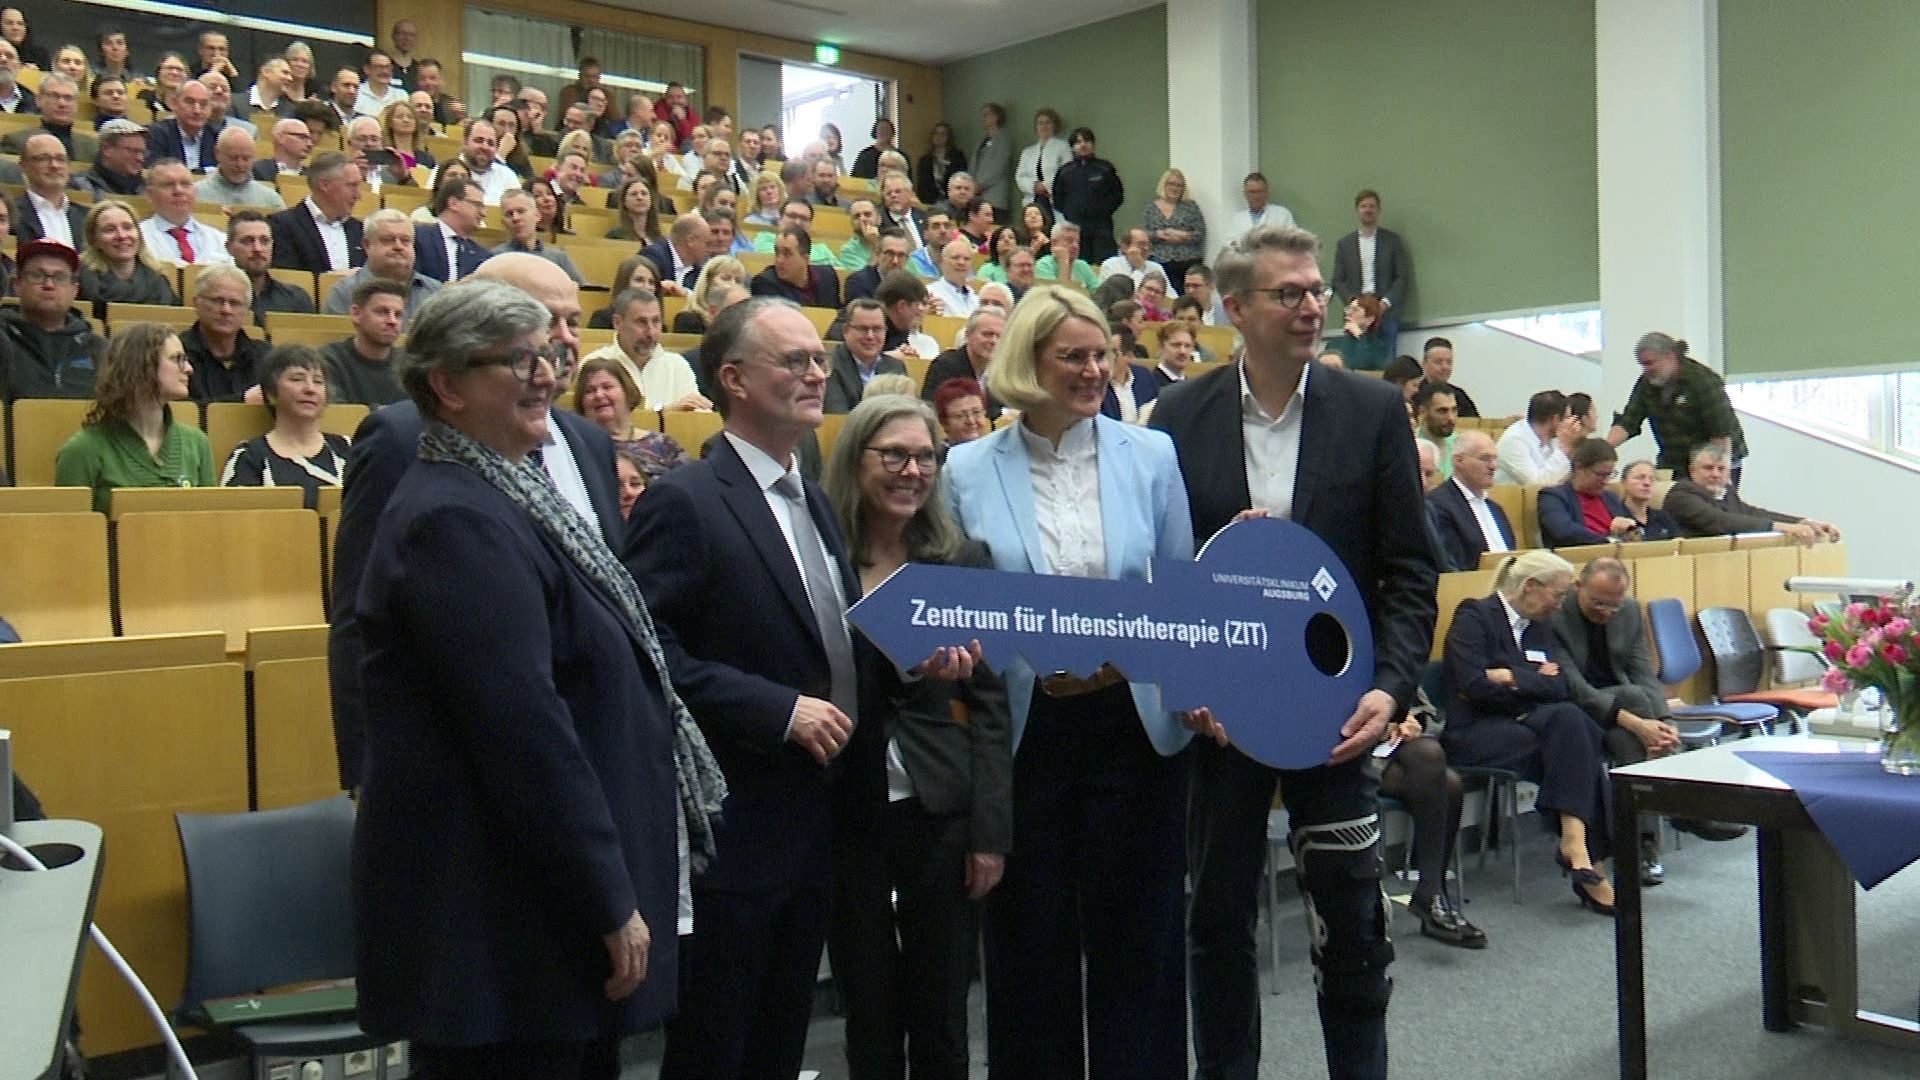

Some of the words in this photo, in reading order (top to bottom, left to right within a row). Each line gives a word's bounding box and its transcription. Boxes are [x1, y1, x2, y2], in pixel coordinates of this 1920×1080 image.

[1262, 588, 1310, 601] AUGSBURG
[910, 598, 1008, 631] Zentrum
[1013, 604, 1046, 633] für
[1050, 607, 1220, 649] Intensivtherapie
[1223, 618, 1268, 651] (ZIT)
